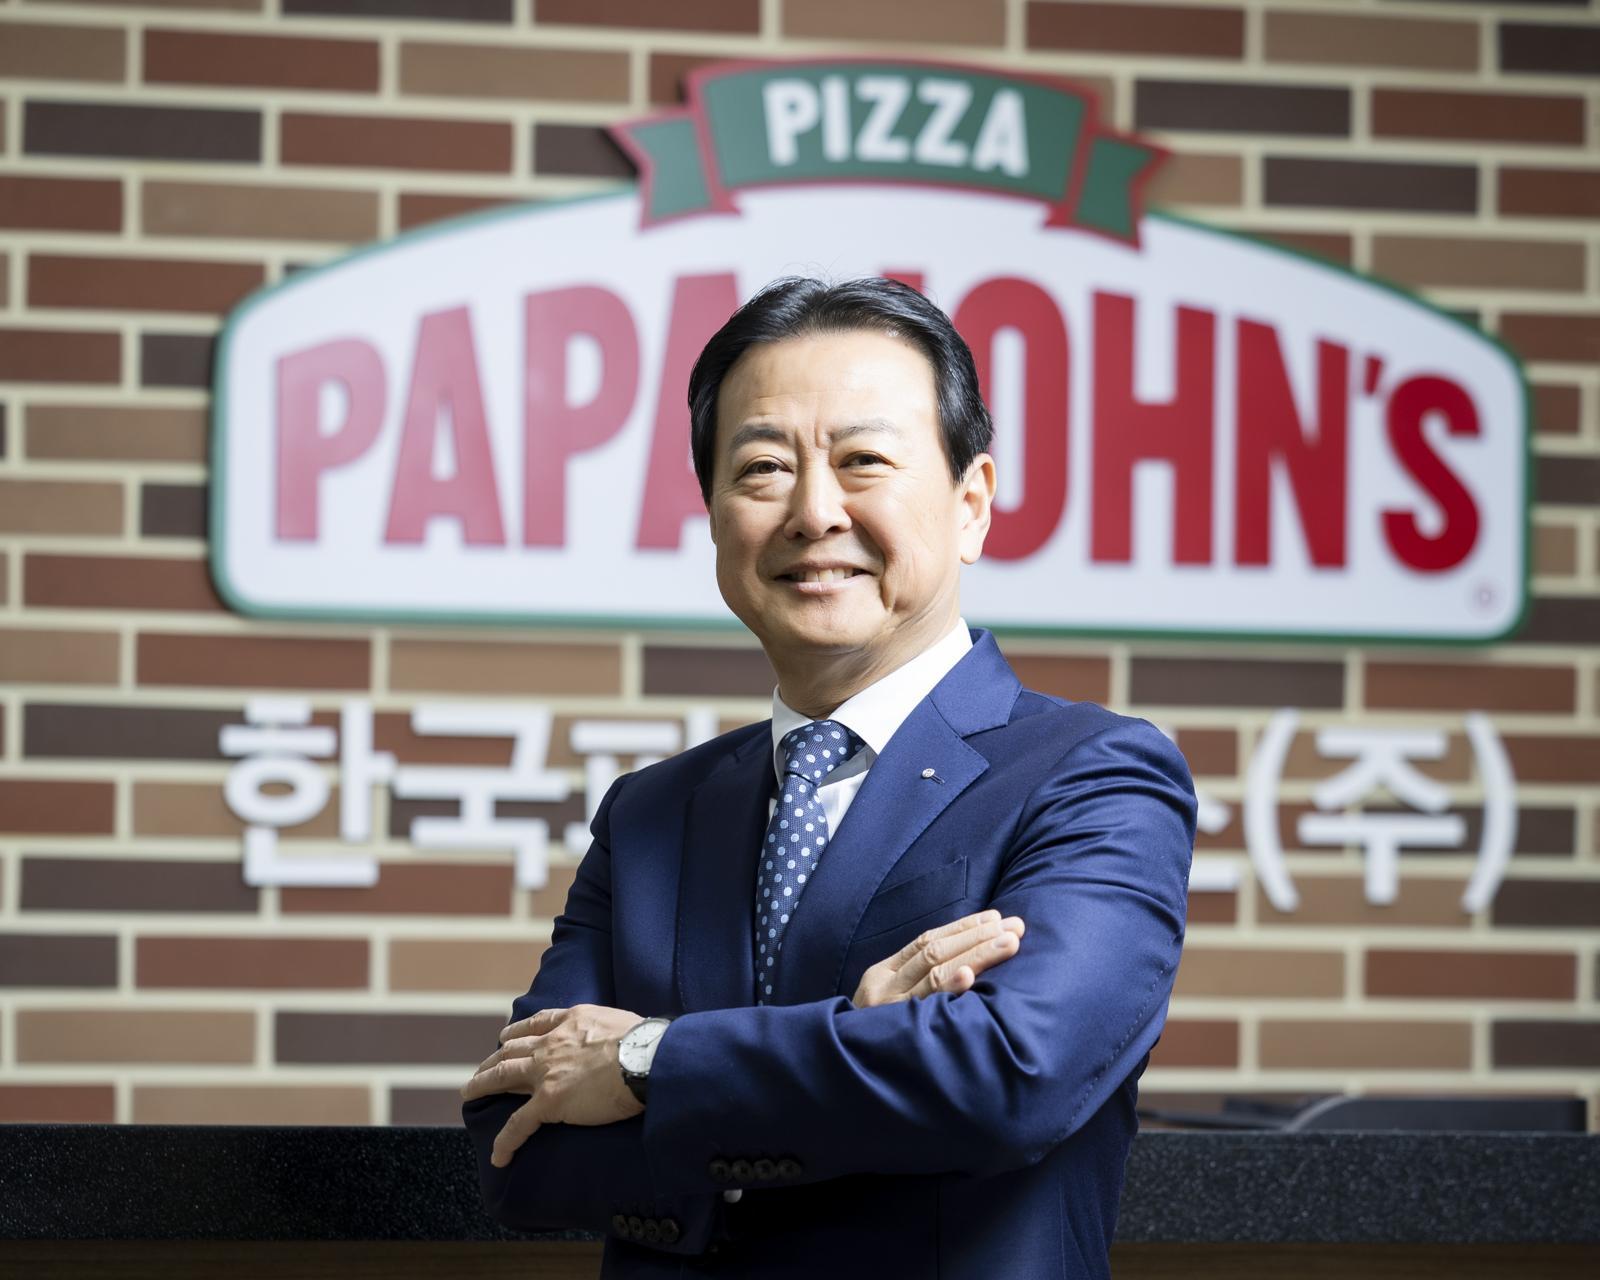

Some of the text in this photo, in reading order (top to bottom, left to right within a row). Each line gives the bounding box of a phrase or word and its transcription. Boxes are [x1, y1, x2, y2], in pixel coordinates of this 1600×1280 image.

[763, 76, 1028, 177] PIZZA
[880, 269, 1482, 574] OHN'S
[1163, 707, 1518, 912] (주)
